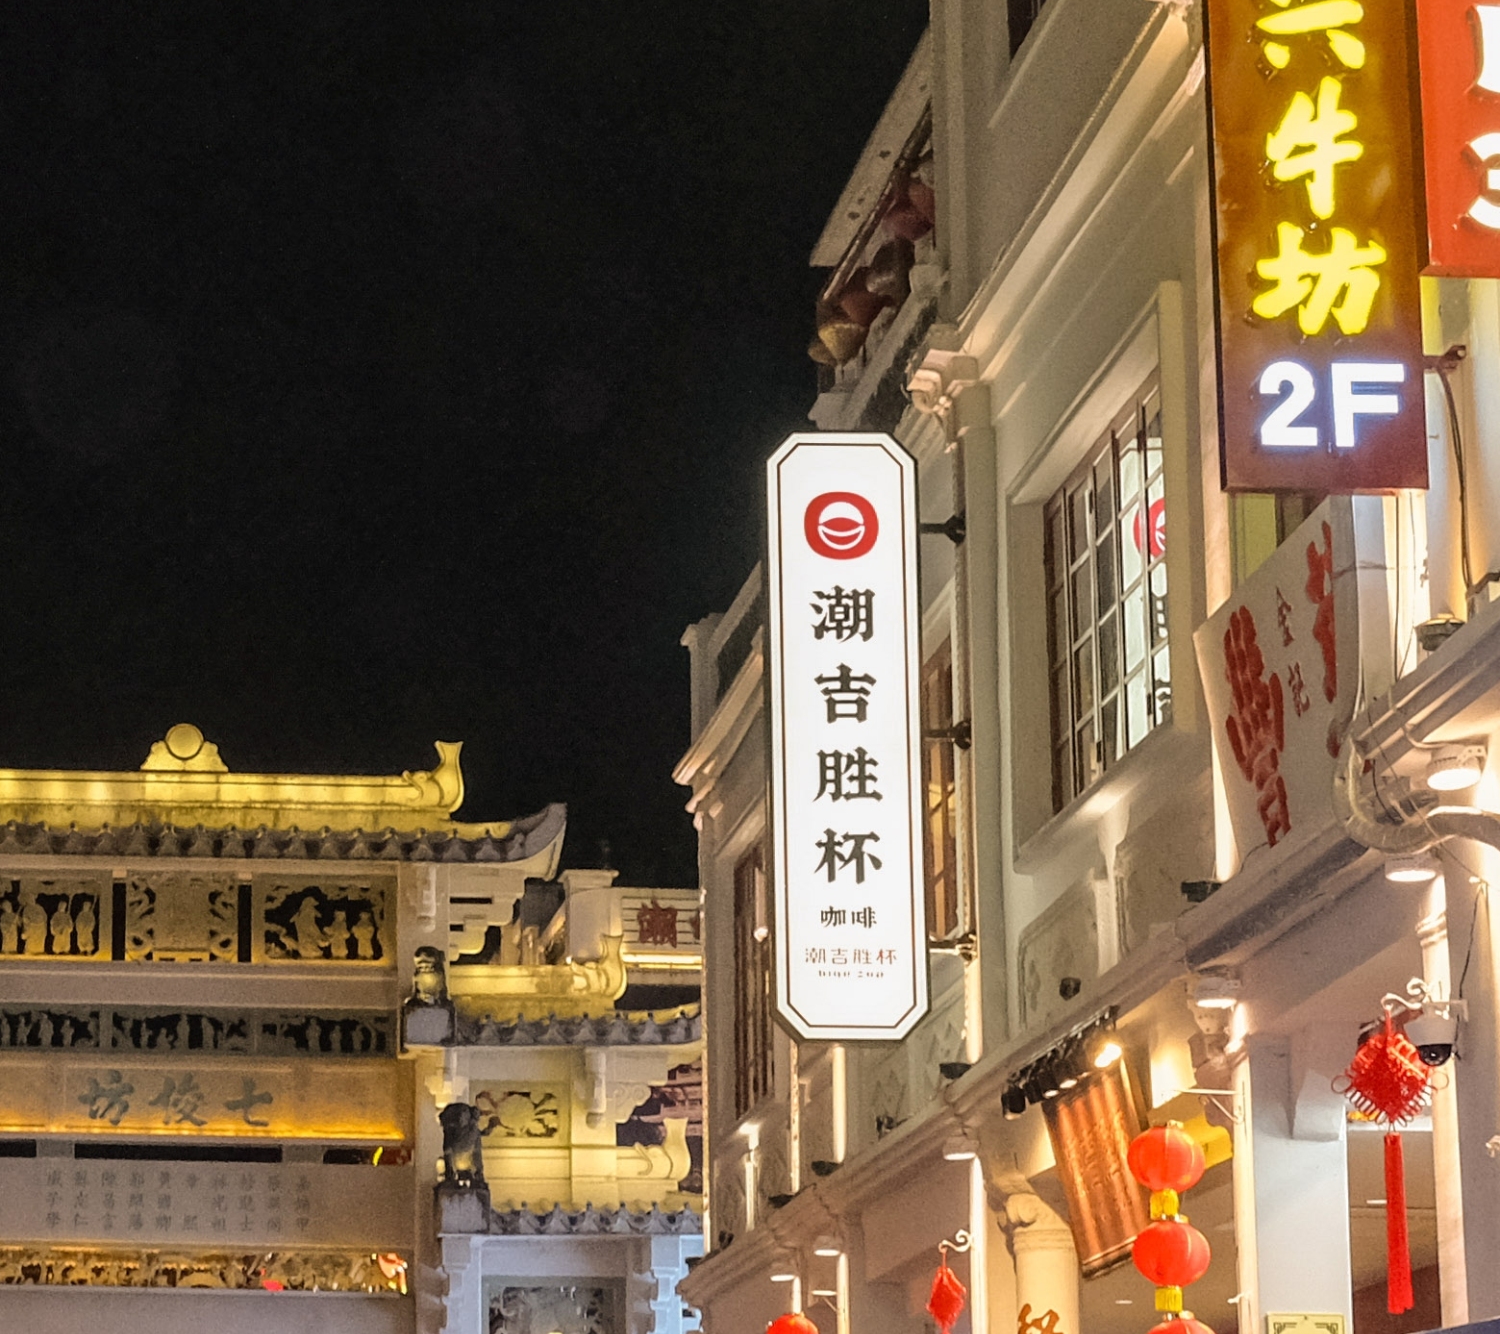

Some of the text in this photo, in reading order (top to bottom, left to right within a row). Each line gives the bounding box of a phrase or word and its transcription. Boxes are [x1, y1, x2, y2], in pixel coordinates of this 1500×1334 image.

[1259, 361, 1405, 448] 2F
[810, 586, 883, 884] 潮吉胜杯
[820, 905, 877, 928] 咖啡
[805, 947, 897, 965] 潮吉胜杯
